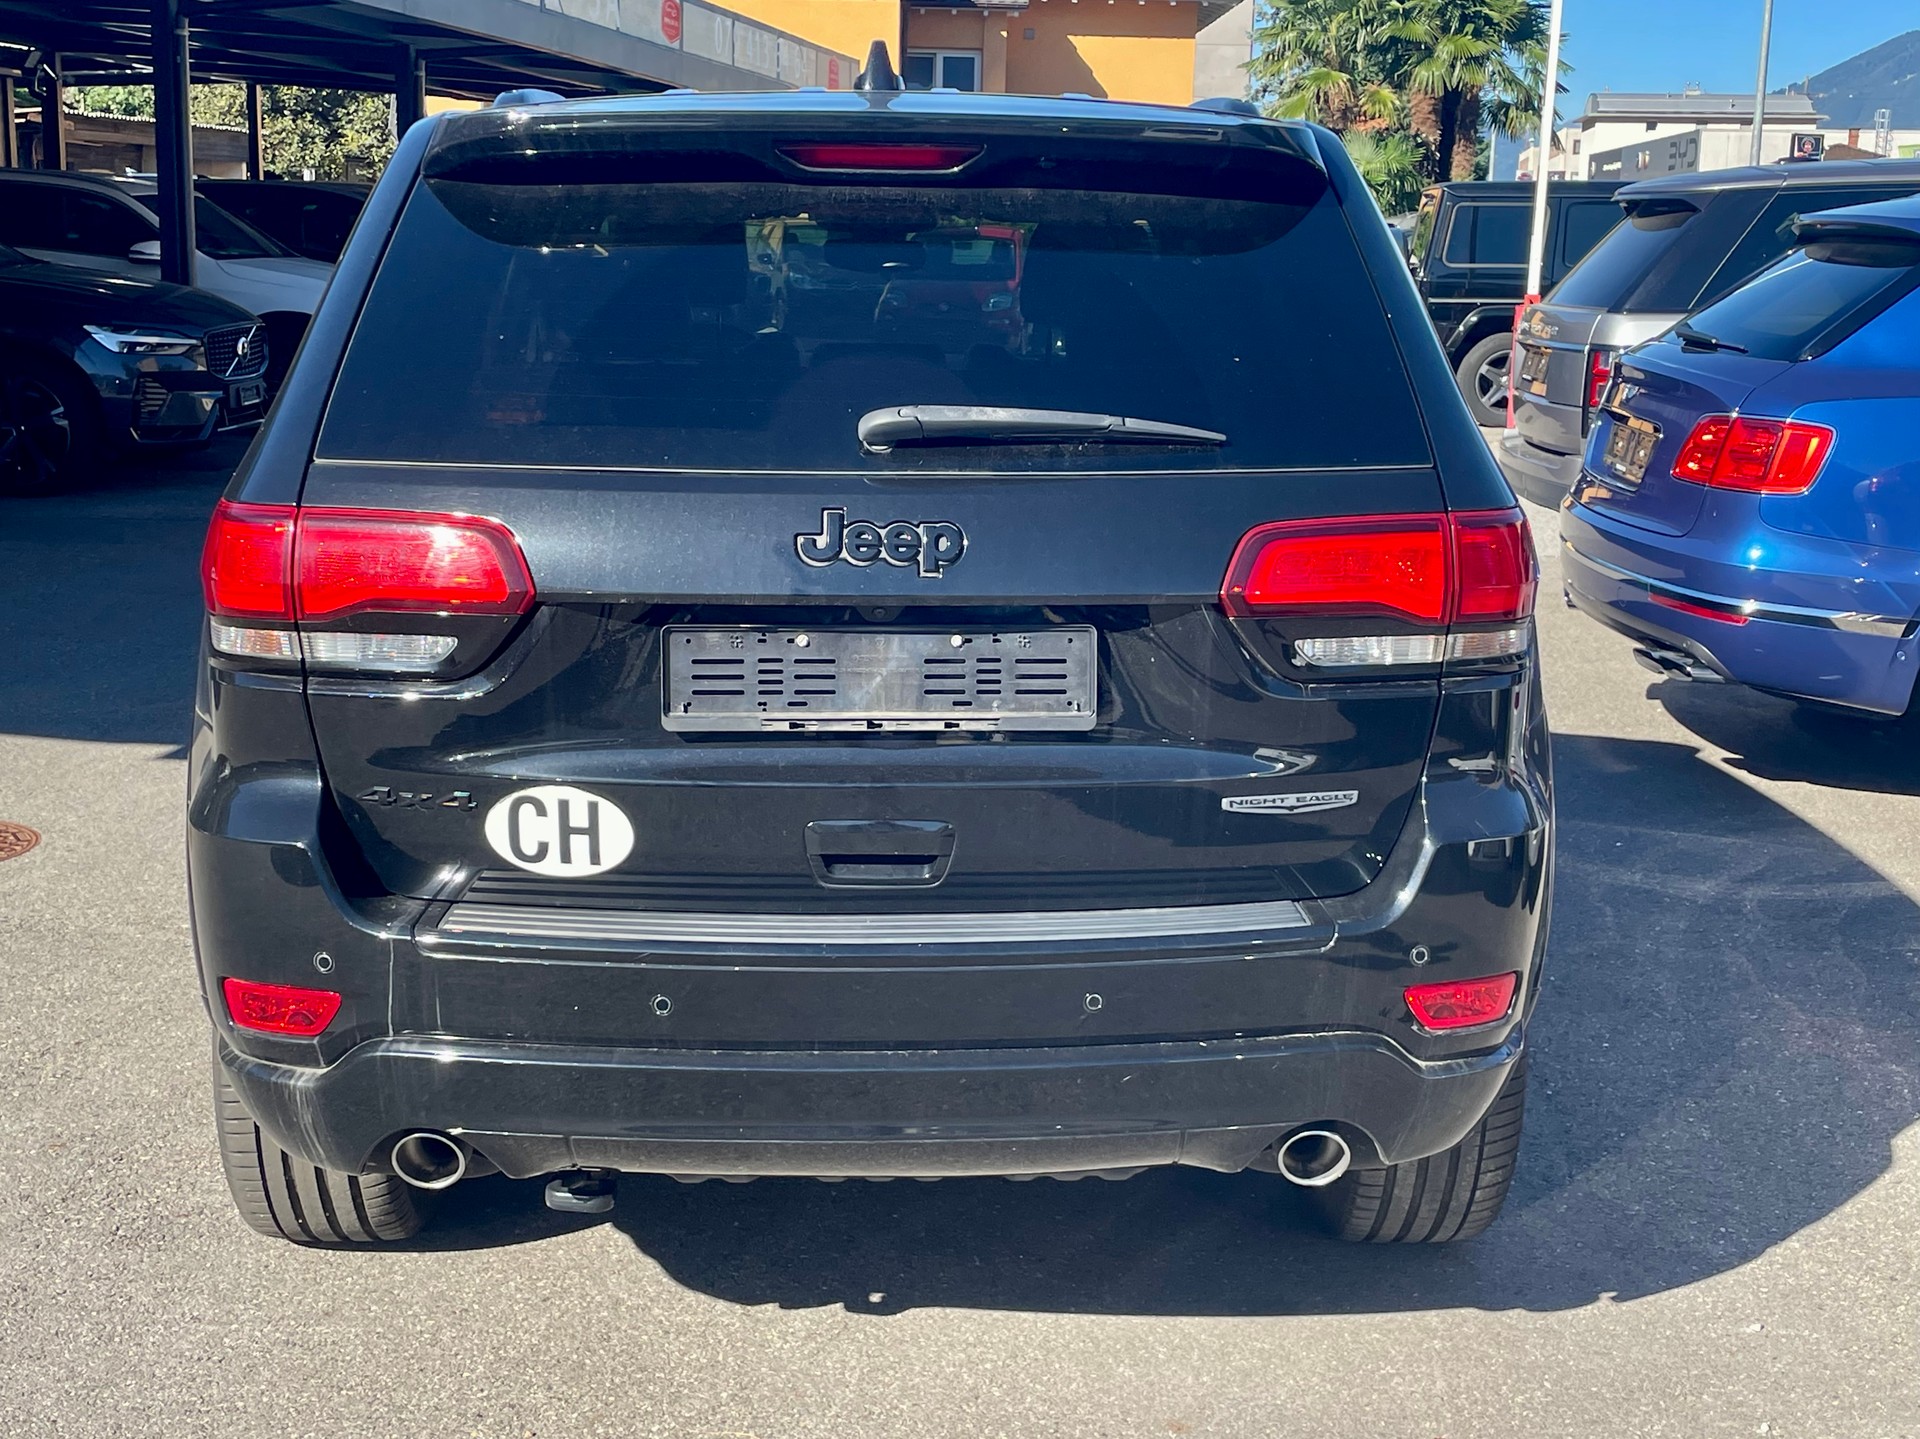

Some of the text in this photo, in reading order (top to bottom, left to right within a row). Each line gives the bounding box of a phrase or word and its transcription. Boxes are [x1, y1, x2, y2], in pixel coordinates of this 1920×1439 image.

[1668, 137, 1698, 171] BYD
[795, 507, 967, 578] Jeep
[1229, 793, 1354, 808] NIGHT EAGLE
[508, 795, 601, 866] CH
